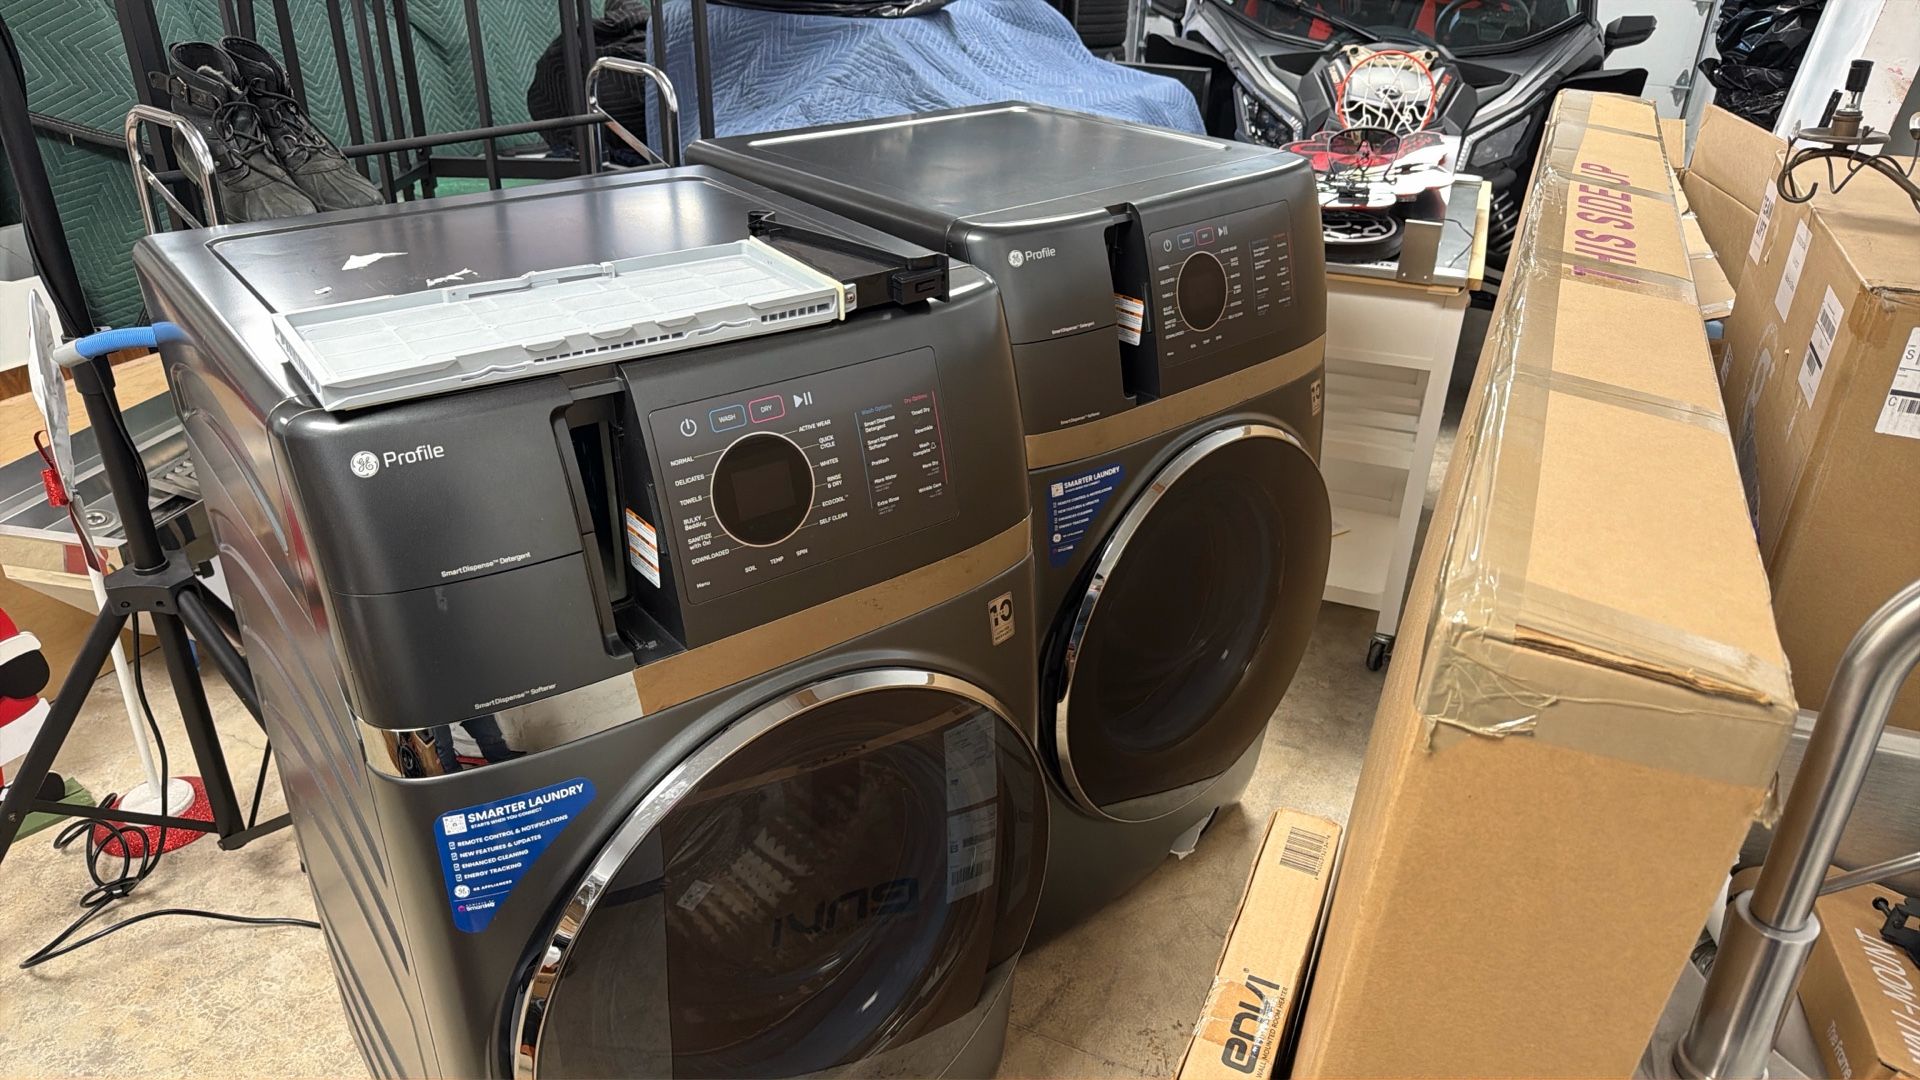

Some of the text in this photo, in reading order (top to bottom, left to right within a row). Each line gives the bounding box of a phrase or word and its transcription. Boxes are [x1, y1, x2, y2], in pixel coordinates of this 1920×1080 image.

[1573, 162, 1640, 284] THIS SIDE UP
[1025, 247, 1056, 262] Profile
[760, 405, 772, 413] DRY
[718, 413, 736, 423] WASH
[798, 419, 831, 432] ACTIVE WEAR
[818, 434, 834, 444] QUICK
[819, 441, 836, 450] CYCLE
[383, 444, 445, 468] Profile
[670, 456, 695, 467] NORMAL
[819, 457, 839, 467] WHITES
[674, 474, 705, 487] DELICATES
[1064, 474, 1093, 489] SMARTER
[1093, 465, 1120, 480] LAUNDRY
[679, 495, 702, 507] TOWELS
[683, 515, 702, 525] BULKY
[819, 512, 848, 525] SELF CLEAN
[687, 532, 712, 544] SANITIZE
[499, 551, 531, 565] Detergent
[691, 548, 730, 565] DOWNLOADED
[796, 548, 808, 557] SPIN
[770, 556, 784, 565] TEMP
[744, 565, 757, 573] SOIL
[530, 683, 557, 695] Softener
[467, 783, 584, 823] SMARTER LAUNDRY
[470, 821, 490, 829] STARTS
[518, 807, 542, 817] CONNECT
[457, 836, 483, 848] REMOTE
[483, 829, 514, 842] CONTROL
[521, 814, 568, 833] NOTIFICATIONS
[475, 844, 507, 855] FEATURES
[513, 833, 542, 846] UPDATES
[462, 849, 529, 869] ENHANCED CLEANING
[464, 862, 522, 879] ENERGY TRACKING
[1256, 986, 1288, 1079] WALL MOUNTED ROOM HEATER
